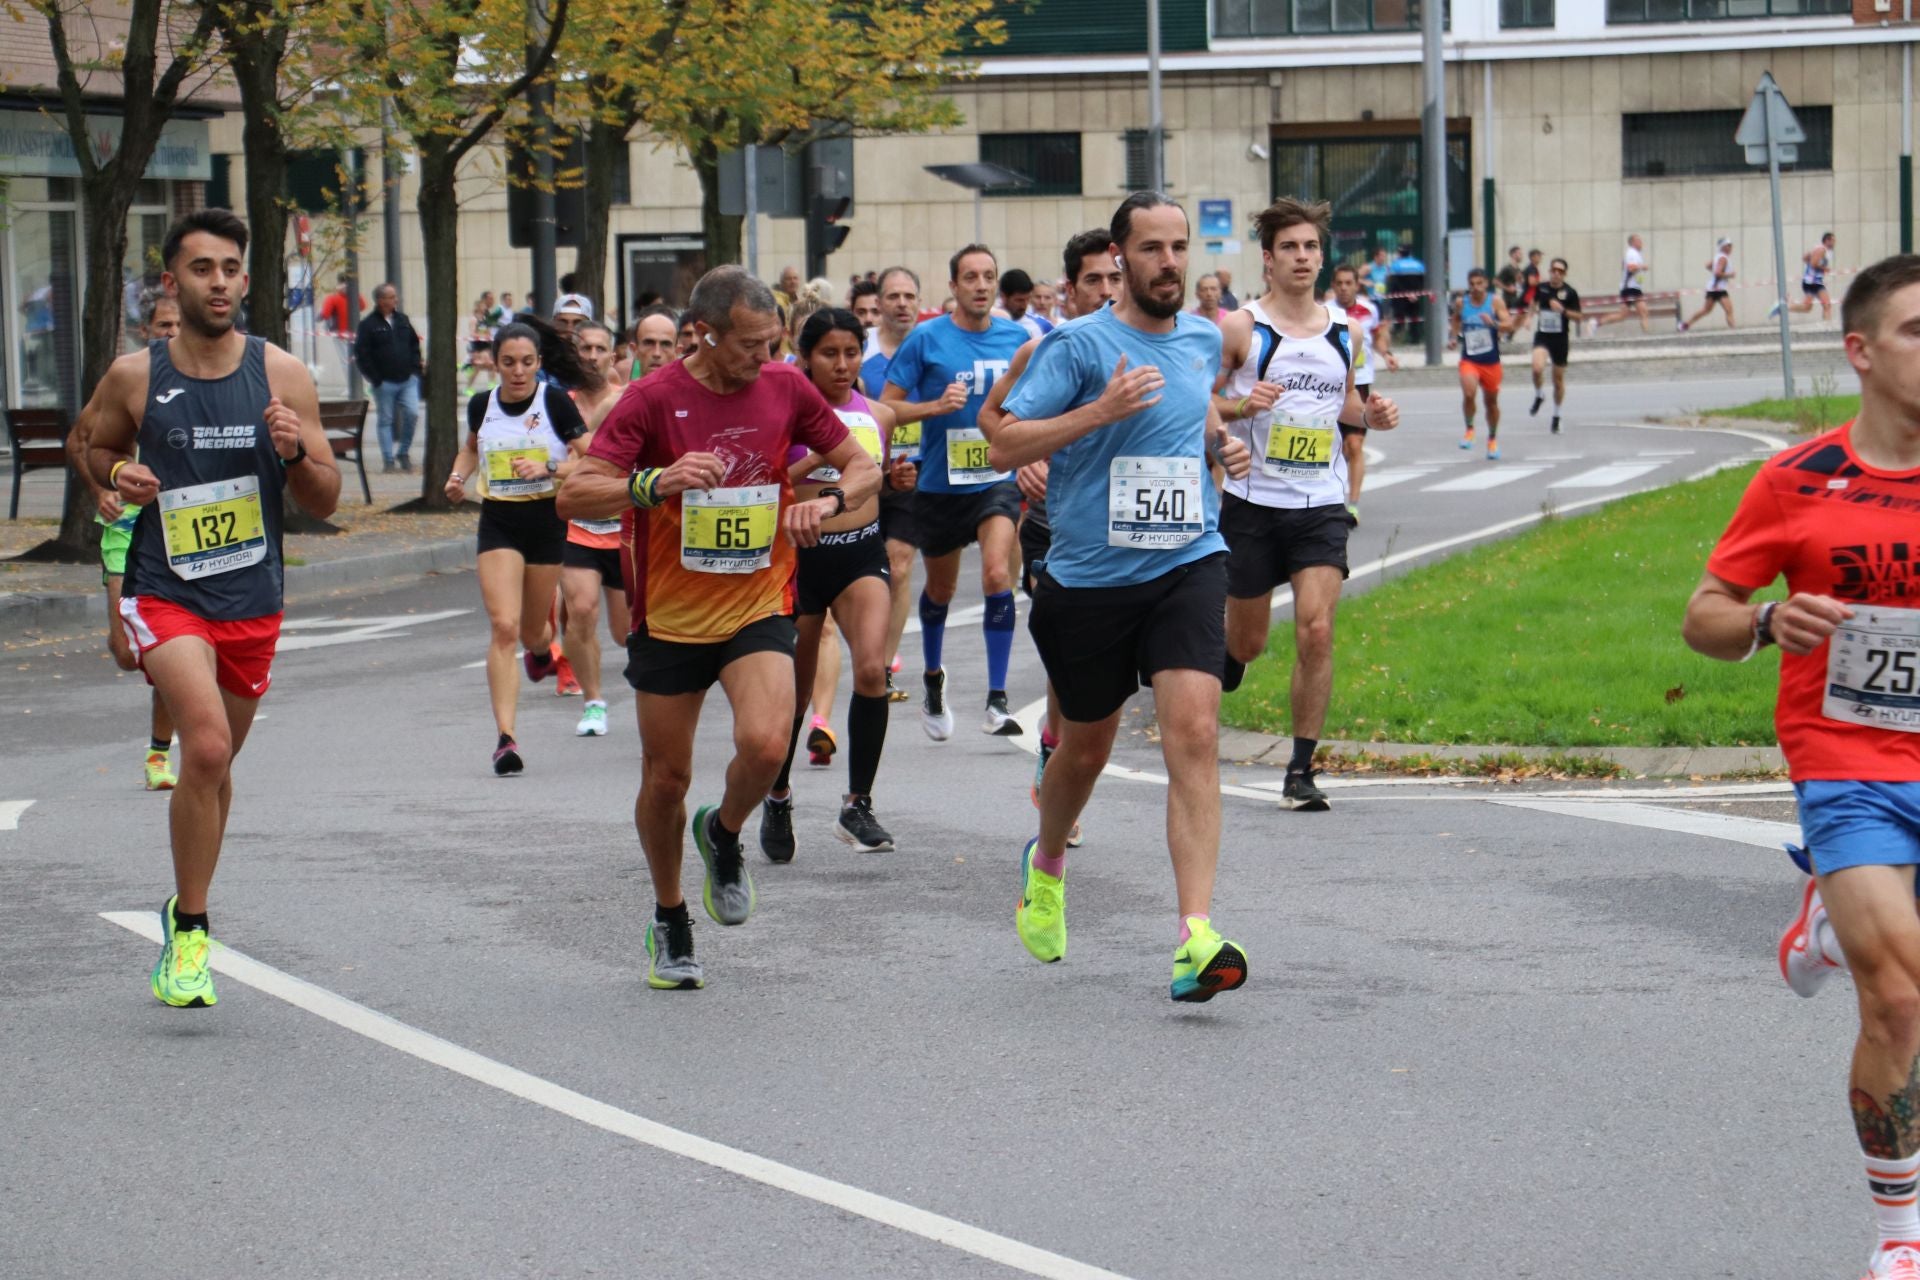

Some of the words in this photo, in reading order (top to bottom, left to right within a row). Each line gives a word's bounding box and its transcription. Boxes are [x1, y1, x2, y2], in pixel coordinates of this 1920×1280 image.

[956, 371, 974, 384] go
[974, 360, 1009, 396] IT
[1271, 373, 1344, 400] telligent
[192, 425, 256, 438] GALGOS
[193, 437, 257, 450] NEGROS
[1287, 435, 1318, 461] 124
[1149, 479, 1175, 488] VICTOR
[1135, 488, 1185, 521] 540
[192, 511, 239, 550] 132
[715, 517, 750, 549] 65
[819, 530, 860, 545] NIKE
[860, 519, 879, 540] PR
[1148, 533, 1190, 543] HYUNDAI
[208, 550, 253, 569] HYUNDAI
[1862, 648, 1920, 695] 25
